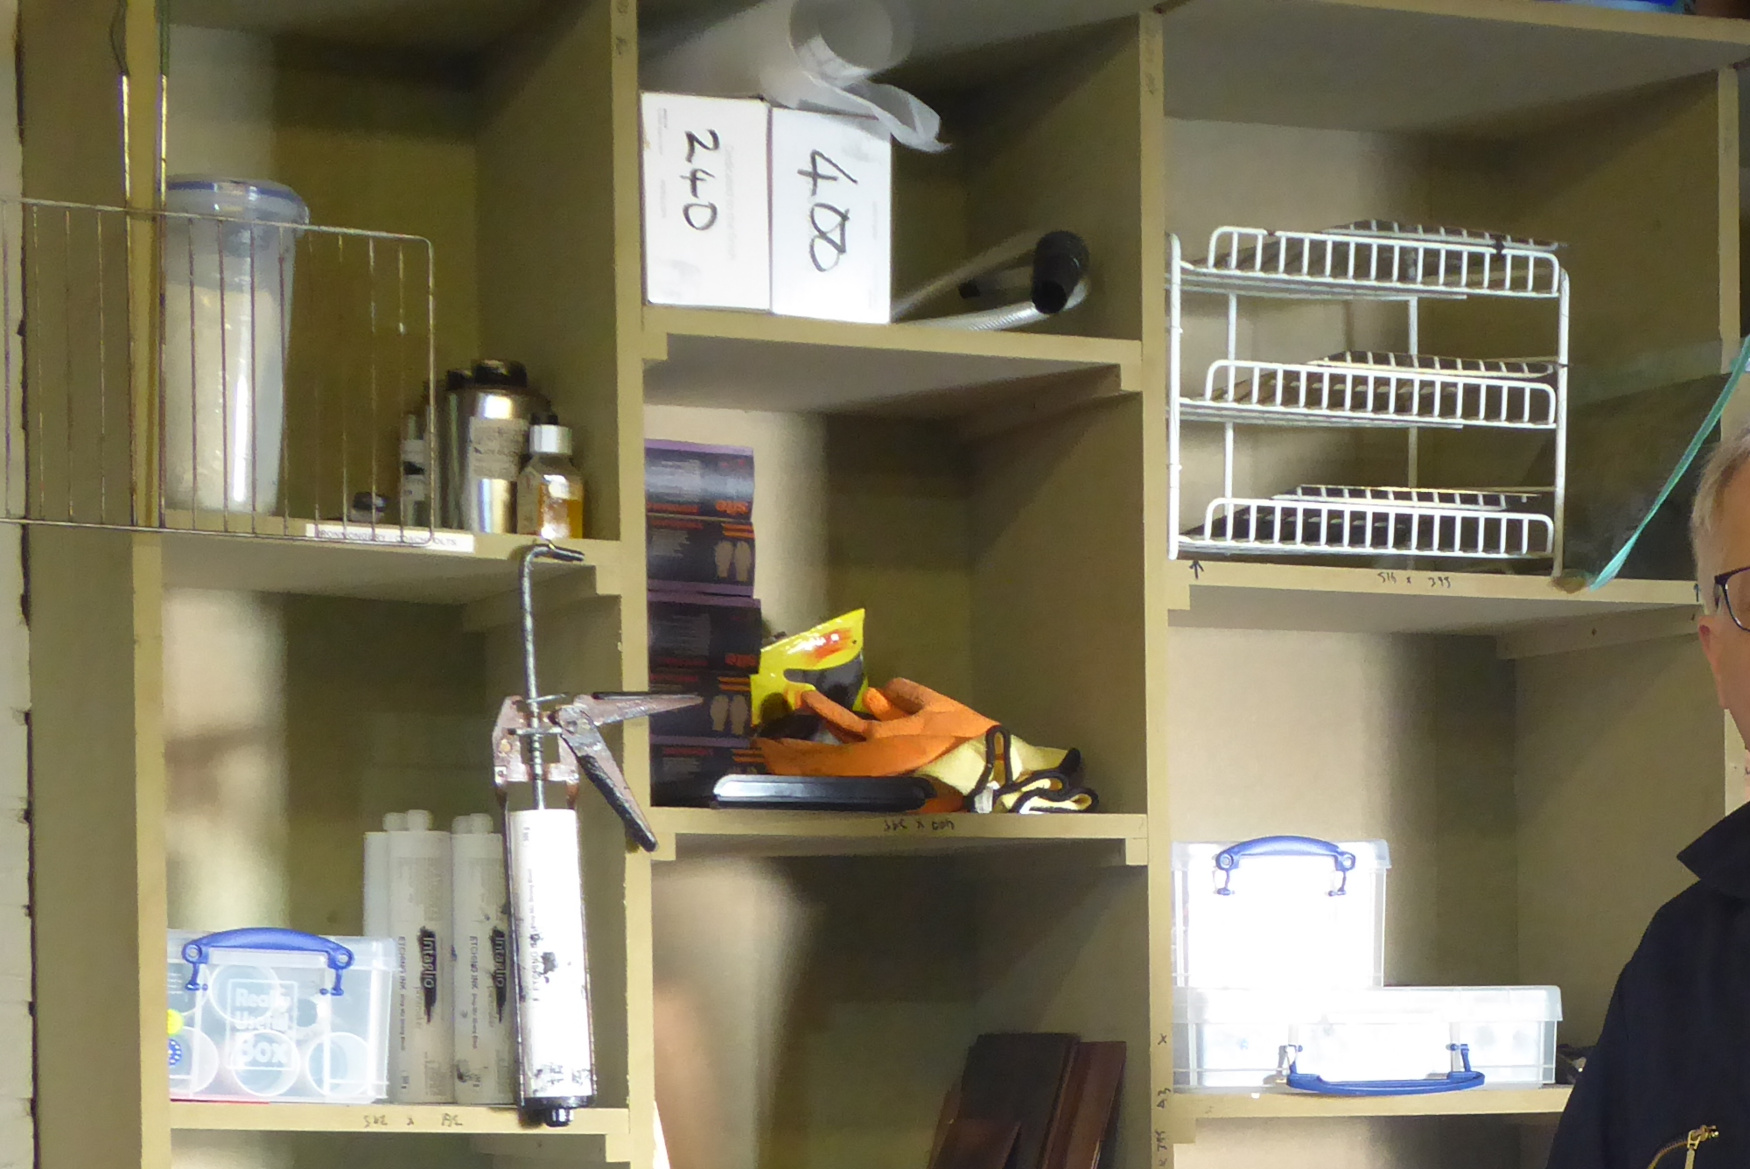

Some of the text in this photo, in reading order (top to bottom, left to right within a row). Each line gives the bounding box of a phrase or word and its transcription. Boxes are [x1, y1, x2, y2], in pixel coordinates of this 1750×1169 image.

[679, 128, 720, 231] 240
[423, 937, 435, 989] Intaglio
[495, 936, 506, 988] Intaglio
